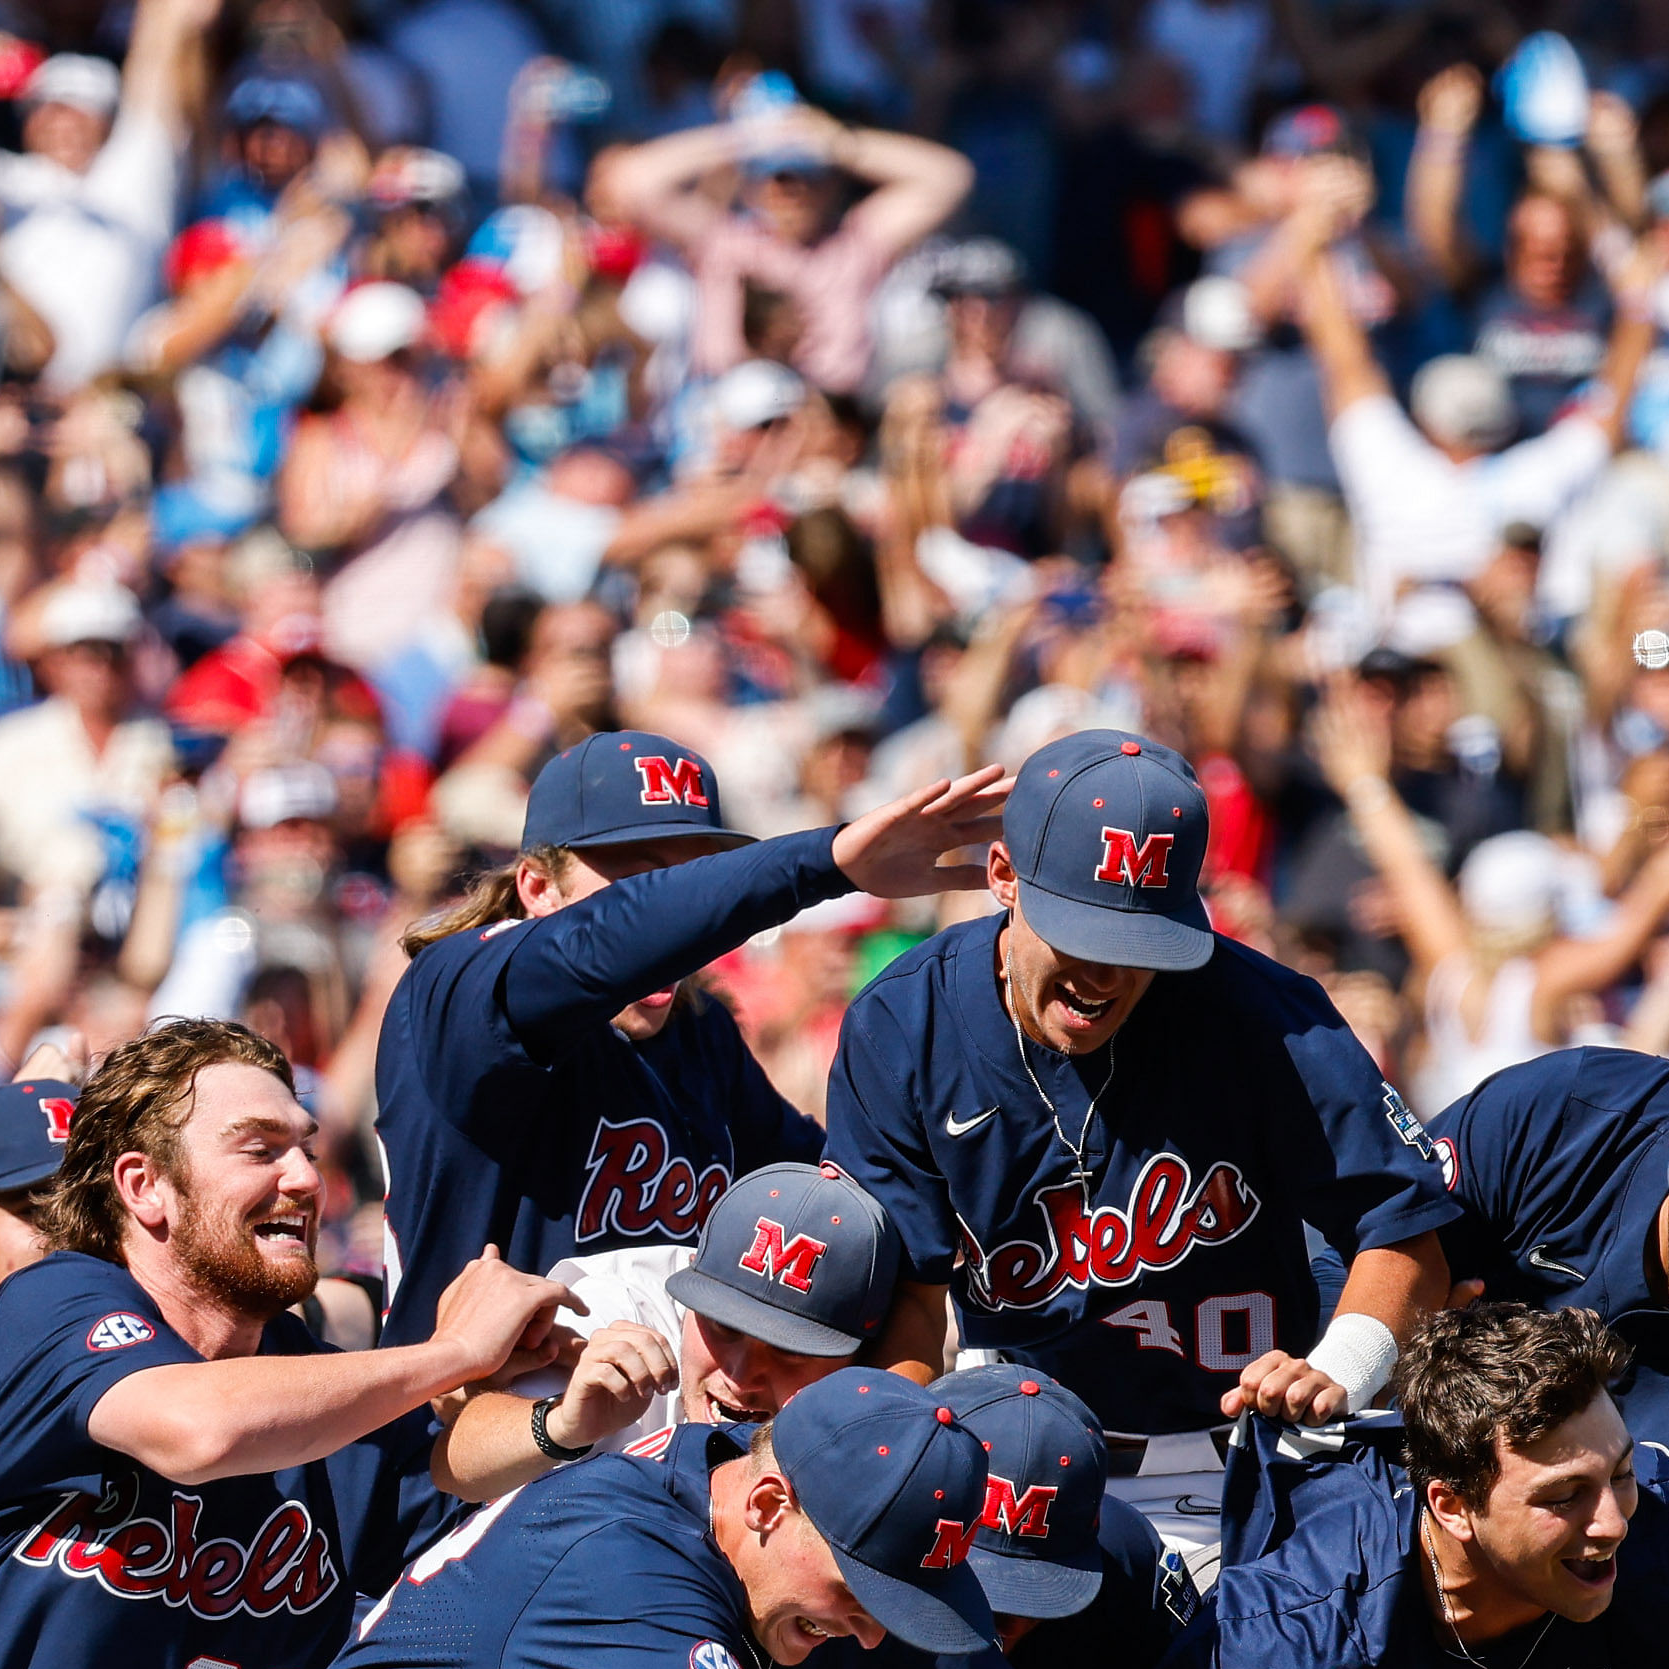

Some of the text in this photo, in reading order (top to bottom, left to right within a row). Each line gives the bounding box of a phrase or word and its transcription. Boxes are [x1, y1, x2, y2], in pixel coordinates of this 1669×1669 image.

[634, 755, 710, 810] M
[1094, 826, 1174, 888] M
[738, 1216, 827, 1295] M
[91, 1313, 151, 1349] SEC
[1098, 1290, 1281, 1373] 40
[981, 1473, 1059, 1539] M
[13, 1471, 340, 1621] Rebels
